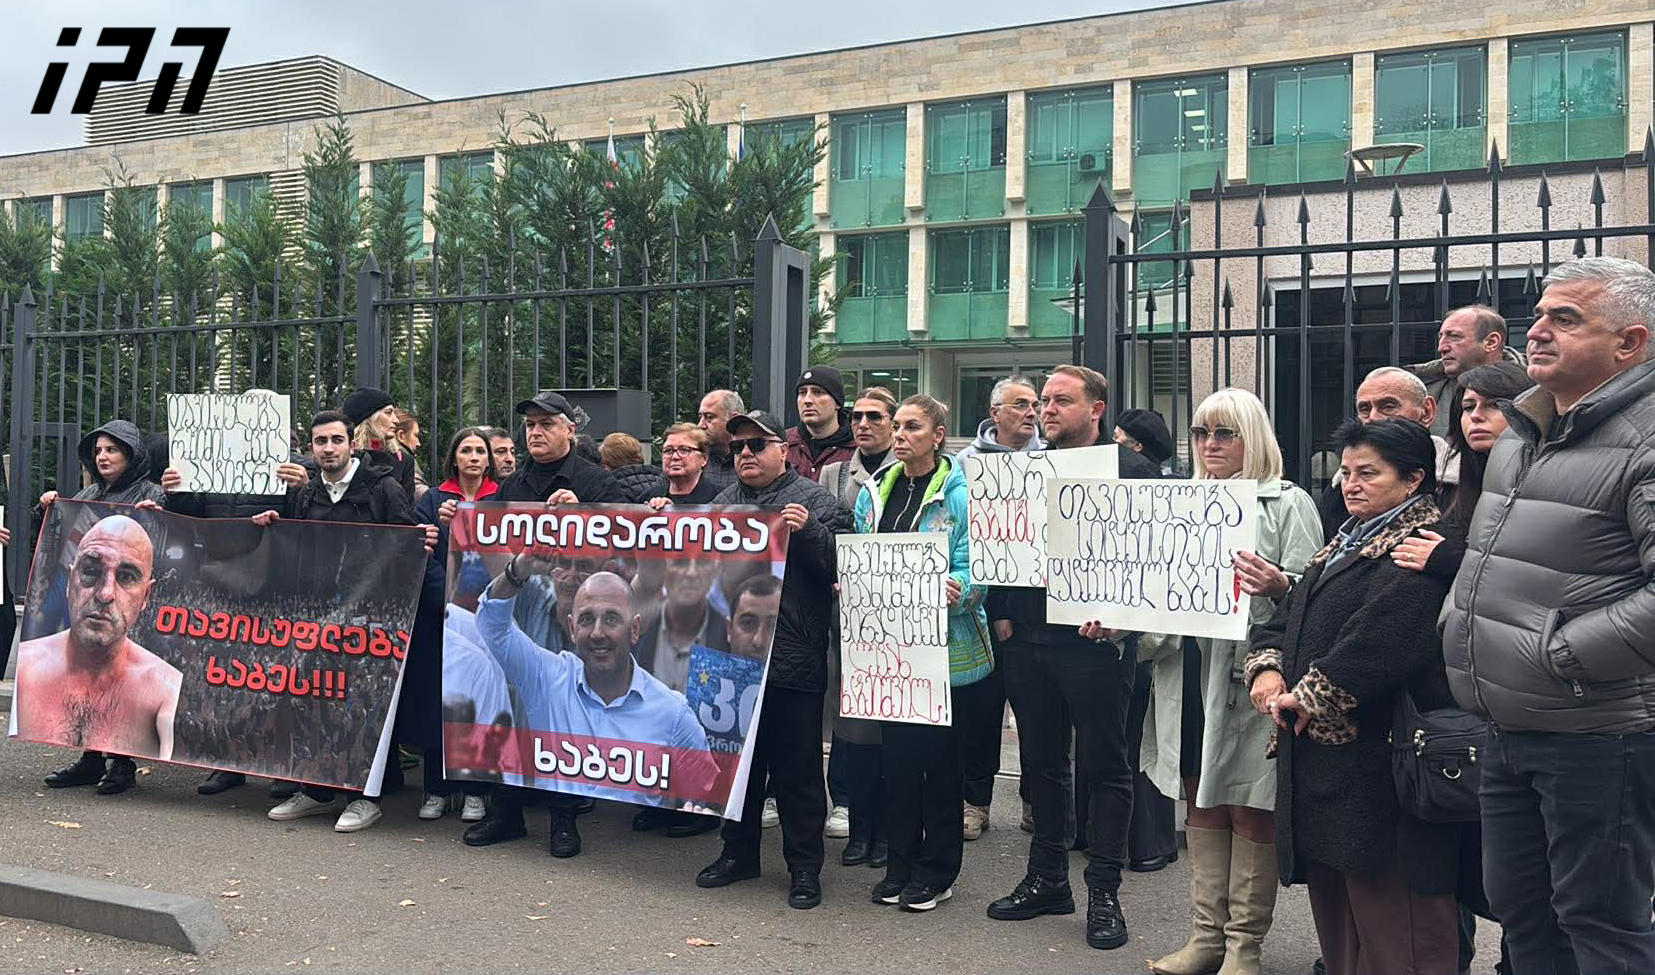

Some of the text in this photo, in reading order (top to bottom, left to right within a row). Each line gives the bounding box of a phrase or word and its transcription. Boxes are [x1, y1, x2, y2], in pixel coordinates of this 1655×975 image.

[1059, 484, 1243, 527] თავისუფლება
[475, 511, 770, 552] სოლიდარობა
[155, 604, 411, 660] თავისუფლება
[205, 655, 347, 699] ხაბეს!!!
[533, 737, 671, 790] ხაბეს!
